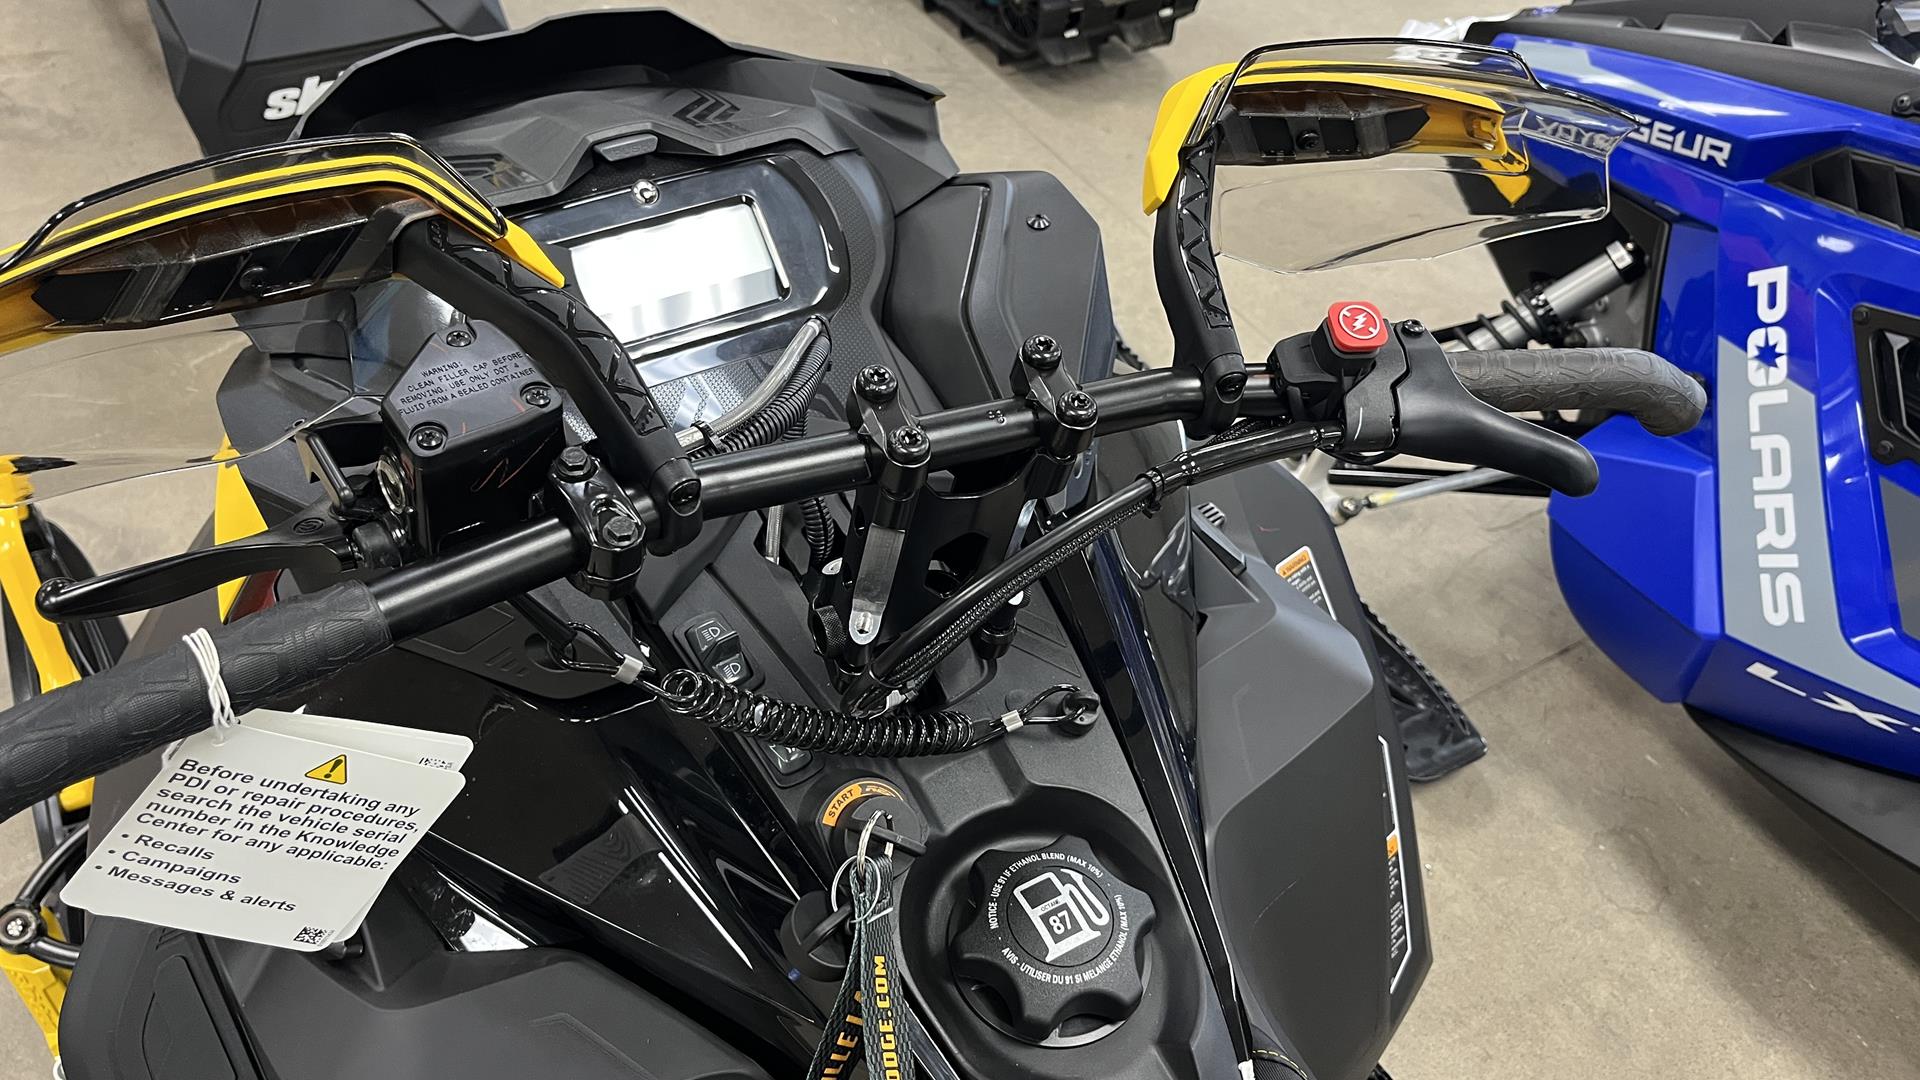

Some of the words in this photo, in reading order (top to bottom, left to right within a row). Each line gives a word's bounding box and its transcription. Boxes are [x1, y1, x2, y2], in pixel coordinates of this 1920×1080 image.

[263, 70, 345, 120] sk
[408, 380, 435, 392] CLEAN
[438, 368, 470, 383] FILLER
[473, 362, 488, 372] CAP
[492, 351, 524, 366] BEFORE
[421, 361, 463, 378] WARNING:
[450, 379, 466, 390] USE
[469, 370, 490, 382] ONLY
[494, 365, 509, 376] DOT
[514, 362, 520, 370] 4
[399, 404, 425, 416] FLUID
[426, 396, 450, 409] FROM
[458, 383, 489, 397] SEALED
[490, 367, 537, 386] CONTAINER
[1747, 265, 1805, 627] POLARIS
[1745, 660, 1920, 735] LX
[179, 758, 254, 784] Before
[259, 778, 381, 812] undertaking
[384, 802, 421, 818] any
[168, 772, 211, 791] PDI
[214, 785, 239, 796] or
[241, 790, 305, 810] repair
[305, 804, 419, 833] procedures,
[828, 788, 855, 818] START
[146, 801, 231, 826] number
[234, 818, 254, 831] in
[259, 822, 297, 838] the
[295, 830, 400, 858] Knowledge
[157, 788, 232, 811] search
[238, 804, 272, 819] the
[278, 813, 349, 834] vehicle
[352, 828, 408, 845] serial
[134, 834, 215, 860] Recalls
[136, 812, 209, 836] Center
[211, 829, 243, 844] for
[245, 838, 283, 853] any
[286, 844, 389, 870] applicable:
[122, 851, 242, 884] Campaigns
[1009, 853, 1042, 873] ETHANOL
[1041, 852, 1066, 861] BLEND
[1066, 854, 1087, 868] (MAX
[997, 875, 1007, 885] 91
[1005, 870, 1013, 879] IF
[1087, 863, 1103, 879] 10%)
[107, 866, 215, 897] Messages
[220, 890, 234, 901] &
[240, 895, 297, 912] alerts
[990, 884, 1003, 897] USE
[988, 901, 999, 930] NOTICE
[1048, 909, 1072, 935] 87
[1118, 911, 1129, 931] (MAX
[1001, 947, 1019, 965] AVIS
[1110, 930, 1129, 962] ETHANOL
[1020, 962, 1051, 983] UTILISER
[1052, 975, 1064, 985] DU
[1065, 975, 1074, 985] 91
[1075, 974, 1083, 983] SI
[1083, 959, 1112, 982] MELANGE
